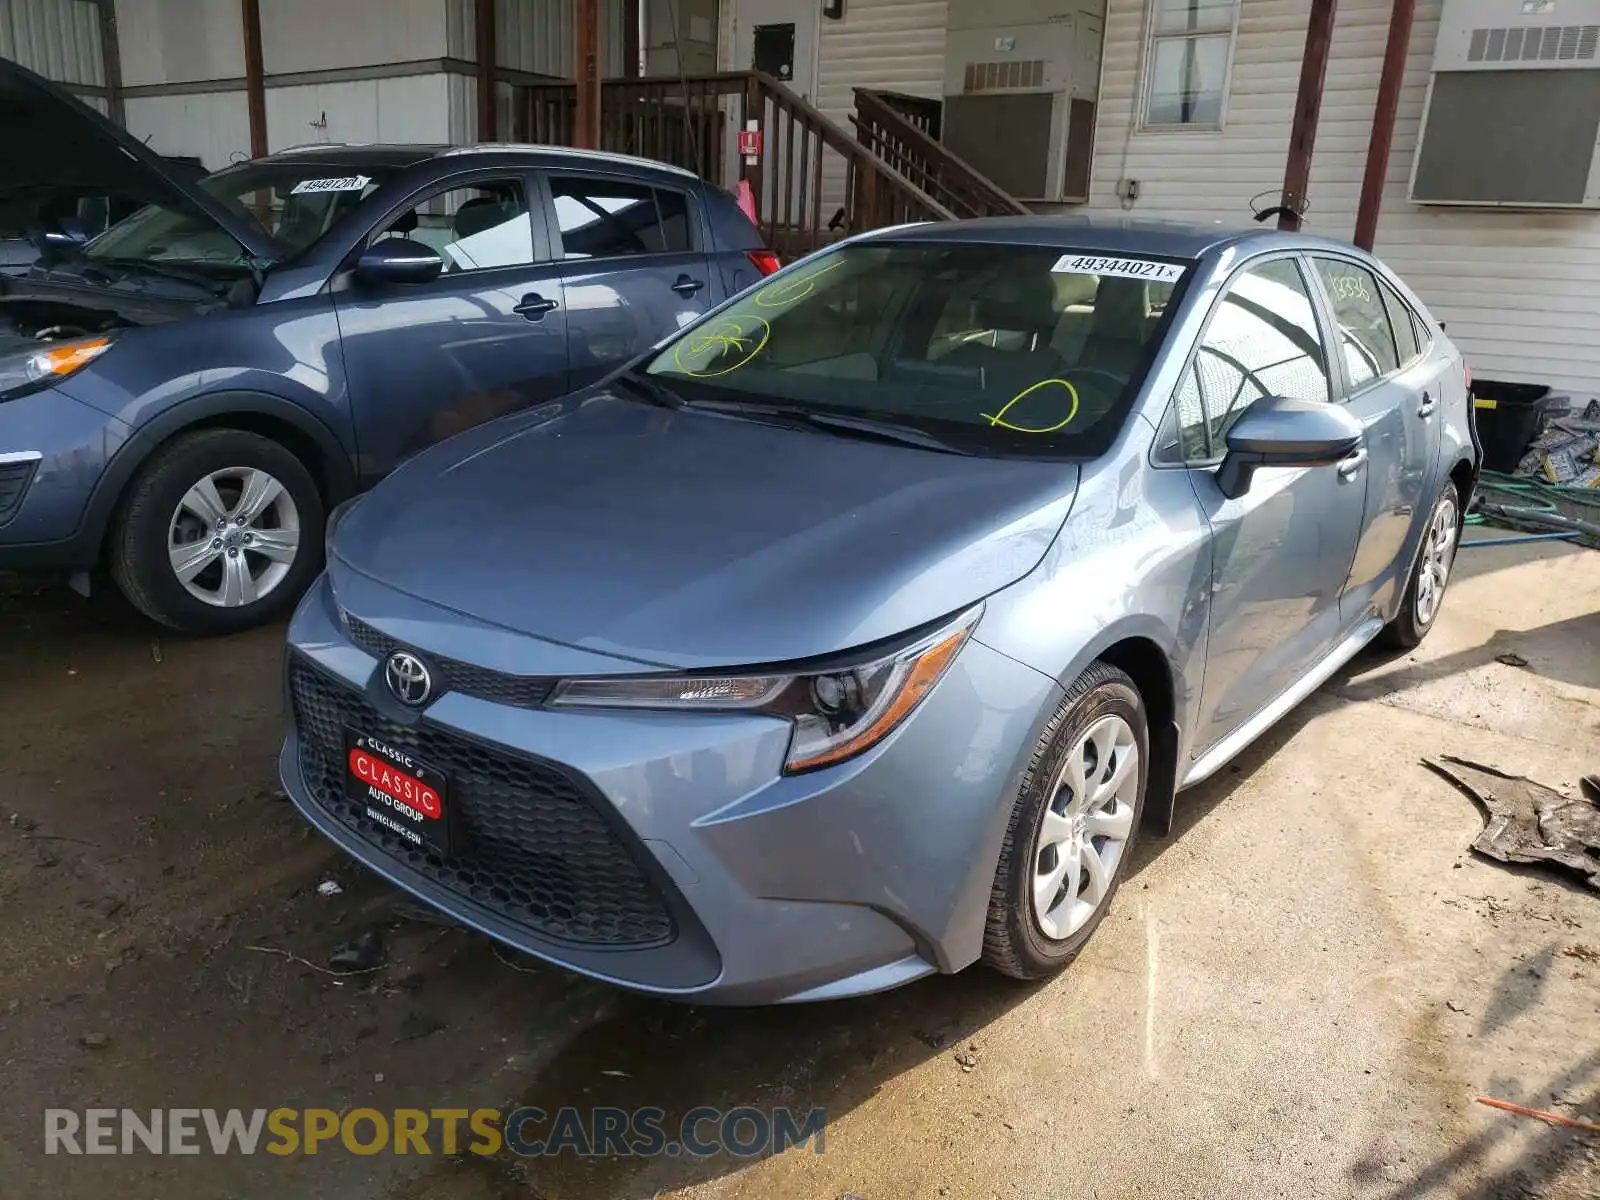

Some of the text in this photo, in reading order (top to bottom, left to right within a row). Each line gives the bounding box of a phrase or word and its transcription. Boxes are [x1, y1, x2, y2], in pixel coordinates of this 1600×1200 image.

[1071, 257, 1166, 277] 49344021
[367, 736, 413, 768] CLASSIC
[357, 757, 434, 811] CLASSIC
[368, 785, 425, 823] AUTO GROUP
[367, 807, 422, 846] DRIVECLASSIC.COM
